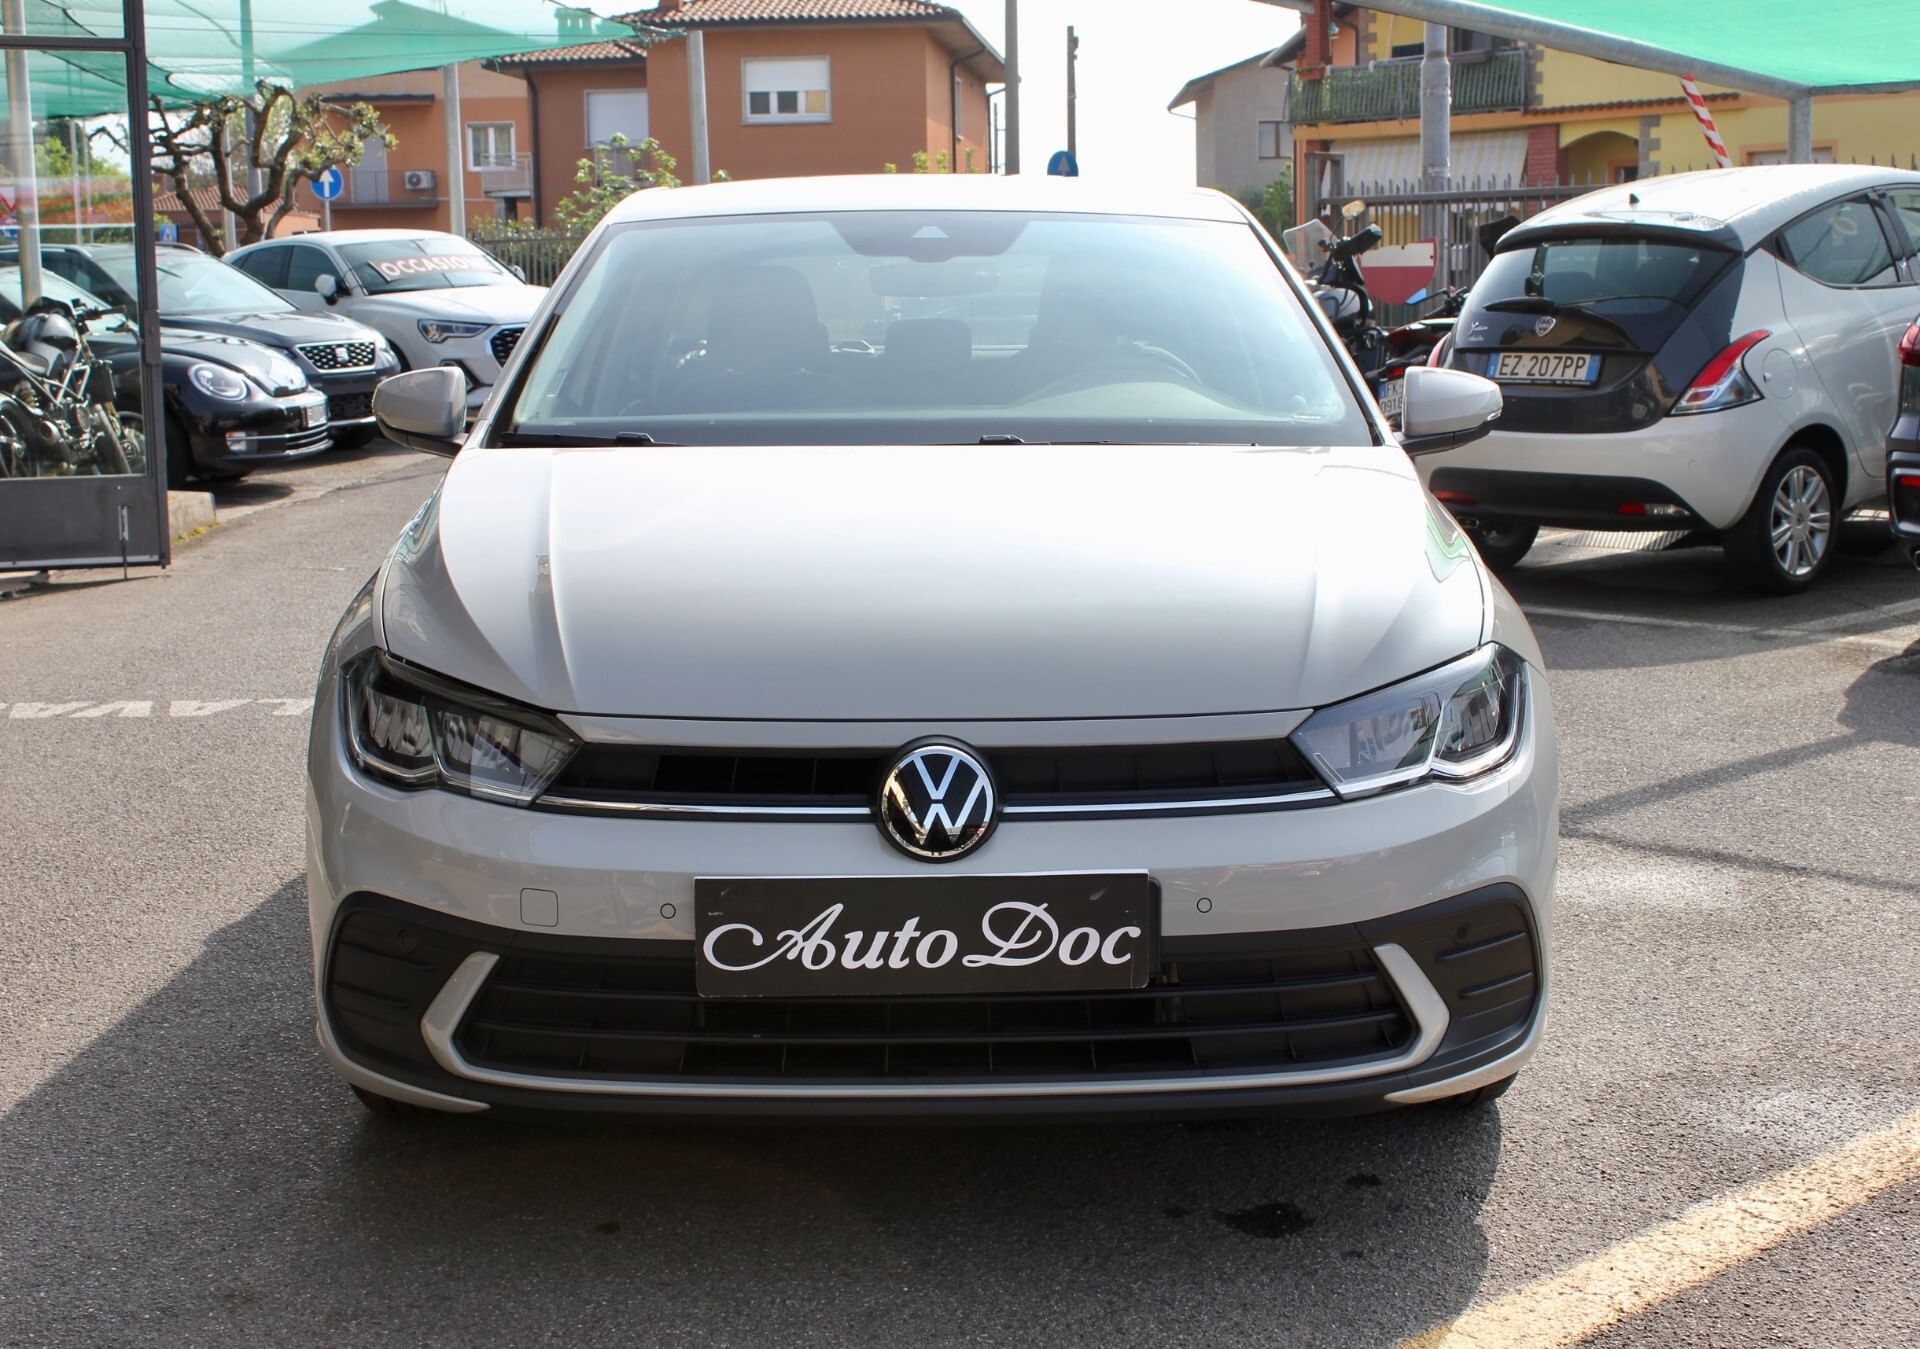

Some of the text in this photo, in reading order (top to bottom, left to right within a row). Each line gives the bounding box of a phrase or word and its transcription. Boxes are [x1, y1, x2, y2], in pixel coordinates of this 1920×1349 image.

[379, 256, 494, 276] OCCASIO
[1499, 354, 1586, 378] EZ 207PP
[703, 901, 1142, 971] Auto Doc
